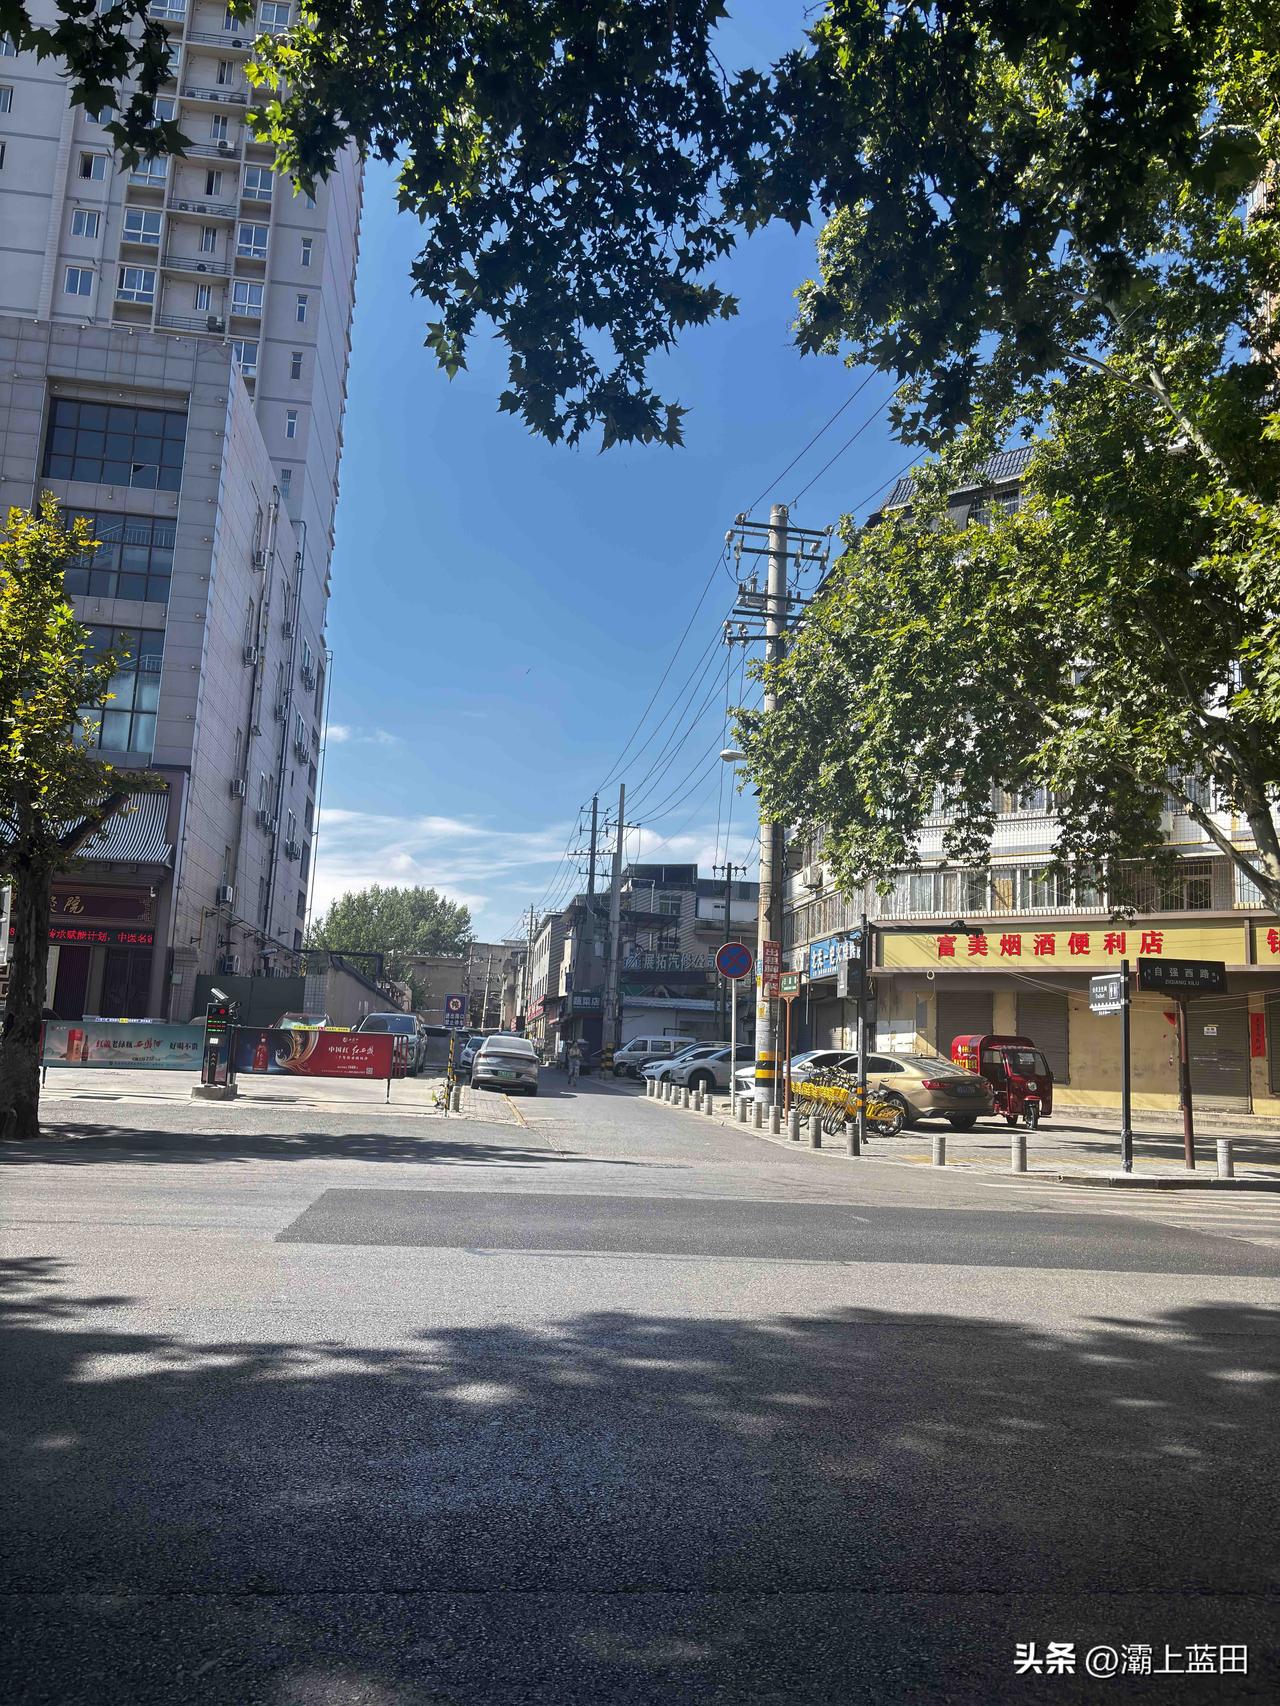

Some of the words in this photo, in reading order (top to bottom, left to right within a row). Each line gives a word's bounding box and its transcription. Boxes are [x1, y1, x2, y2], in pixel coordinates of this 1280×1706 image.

[936, 931, 1164, 957] 富美烟酒便利店
[1154, 966, 1209, 979] 自强西路
